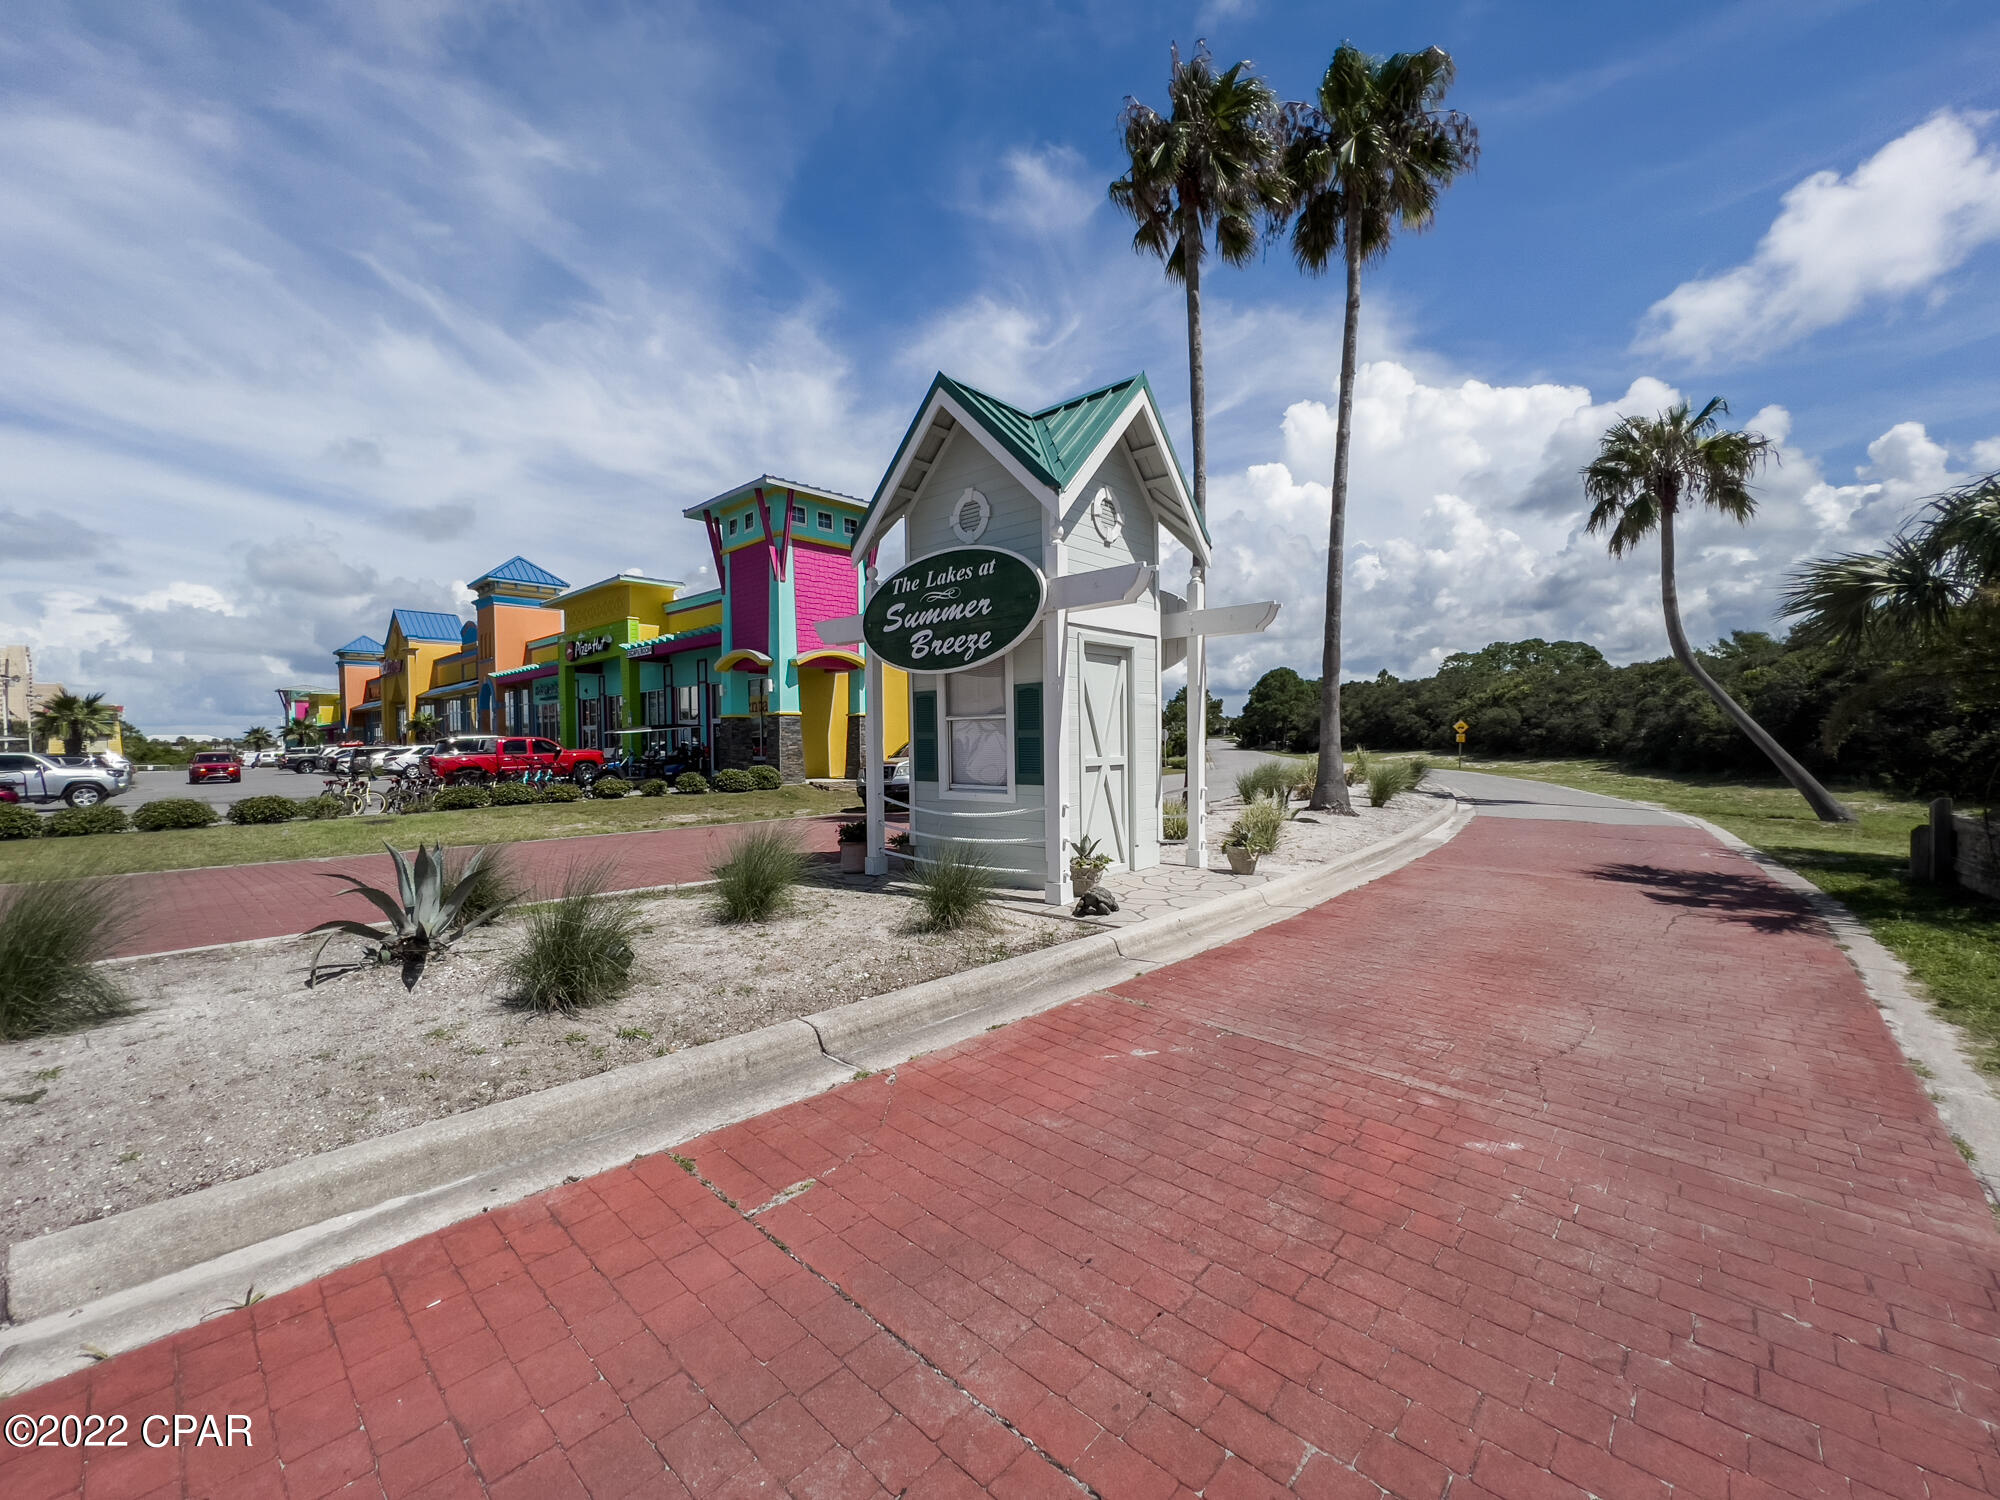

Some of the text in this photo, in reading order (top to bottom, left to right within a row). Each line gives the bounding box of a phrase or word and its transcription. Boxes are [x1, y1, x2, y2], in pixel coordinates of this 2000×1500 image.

[892, 558, 996, 595] The Lakes at
[883, 598, 992, 633] Summer
[574, 636, 605, 659] Pizza Hut
[910, 629, 992, 661] Breeze
